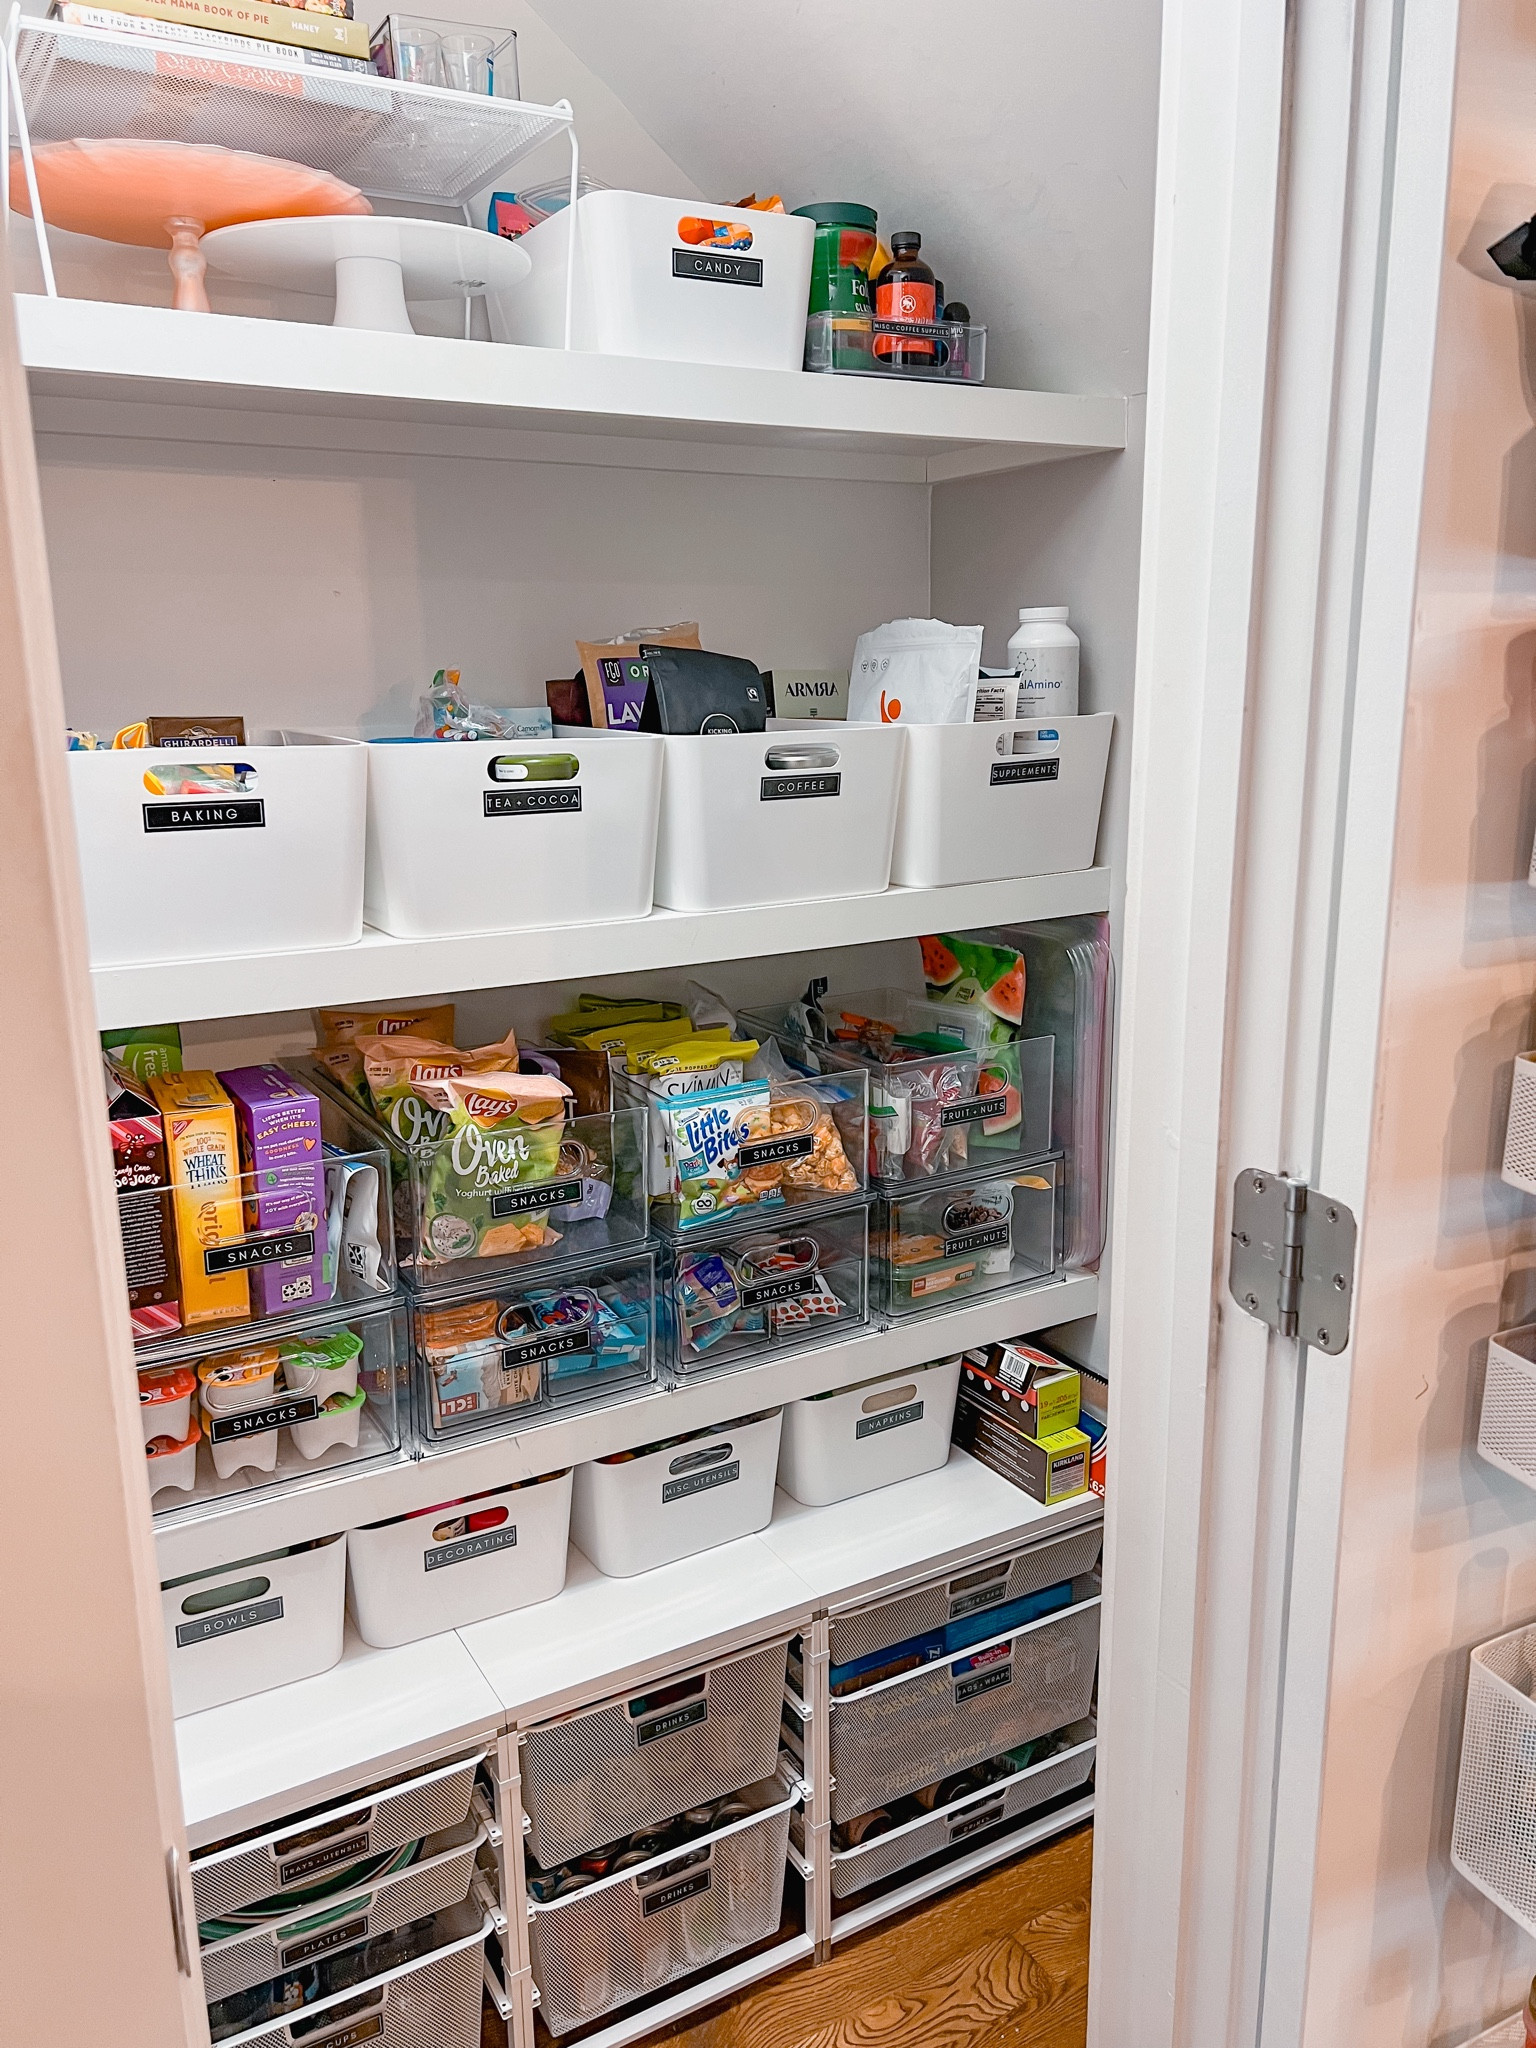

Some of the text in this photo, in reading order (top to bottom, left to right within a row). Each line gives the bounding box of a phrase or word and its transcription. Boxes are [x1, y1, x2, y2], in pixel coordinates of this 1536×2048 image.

[170, 0, 200, 11] MAMA
[203, 4, 233, 18] BOOK
[237, 10, 250, 21] OF
[253, 14, 270, 25] PIE
[291, 21, 320, 34] HANEY
[275, 46, 299, 58] BOOK
[694, 260, 741, 276] CANDY
[874, 322, 891, 331] MISC
[895, 324, 920, 333] COFFEE
[921, 327, 949, 336] SUPPLIES
[1018, 679, 1061, 690] alAmino
[164, 738, 235, 747] GHIRARDELLI
[992, 765, 1057, 779] SUPPLEMENTS
[777, 780, 825, 793] COFFEE
[487, 798, 512, 808] TEA
[527, 794, 578, 806] COCOA
[171, 808, 238, 822] BAKING
[143, 1049, 158, 1078] fres
[467, 1093, 517, 1117] Lay's
[942, 1109, 973, 1123] FRUIT
[980, 1101, 1005, 1113] NUTS
[261, 1108, 306, 1123] LIFE'S BETTER
[268, 1116, 289, 1126] WHEN
[256, 1120, 318, 1140] EASY CHEESY.
[685, 1108, 731, 1154] Little
[182, 1144, 226, 1156] WHOLE GRAIN
[264, 1142, 300, 1155] GOODNESS
[452, 1124, 530, 1176] Oven
[704, 1122, 750, 1165] Bites
[753, 1142, 800, 1160] SNACKS
[183, 1153, 226, 1170] WHEAT
[474, 1160, 519, 1188] Baked
[456, 1188, 492, 1200] Yoghurt
[510, 1189, 565, 1208] SNACKS
[946, 1238, 973, 1253] FRUIT
[983, 1229, 1007, 1243] NUTS
[227, 1242, 293, 1263] SNACKS
[756, 1281, 801, 1300] SNACKS
[520, 1338, 574, 1360] SNACKS
[233, 1407, 297, 1431] SNACKS
[868, 1410, 912, 1430] NAPKINS
[1052, 1453, 1084, 1469] KIRKLAND
[694, 1466, 738, 1486] UTENSILS
[427, 1531, 514, 1565] DECORATING
[203, 1610, 258, 1634] BOWLS
[984, 1670, 1010, 1684] WRAPS
[655, 1713, 690, 1732] DRINKS
[284, 1860, 314, 1877] TRAYS
[323, 1840, 366, 1860] UTENSILS
[660, 1882, 694, 1903] DRINKS
[303, 1930, 347, 1953] PLATES
[326, 2031, 357, 2048] CUPS
